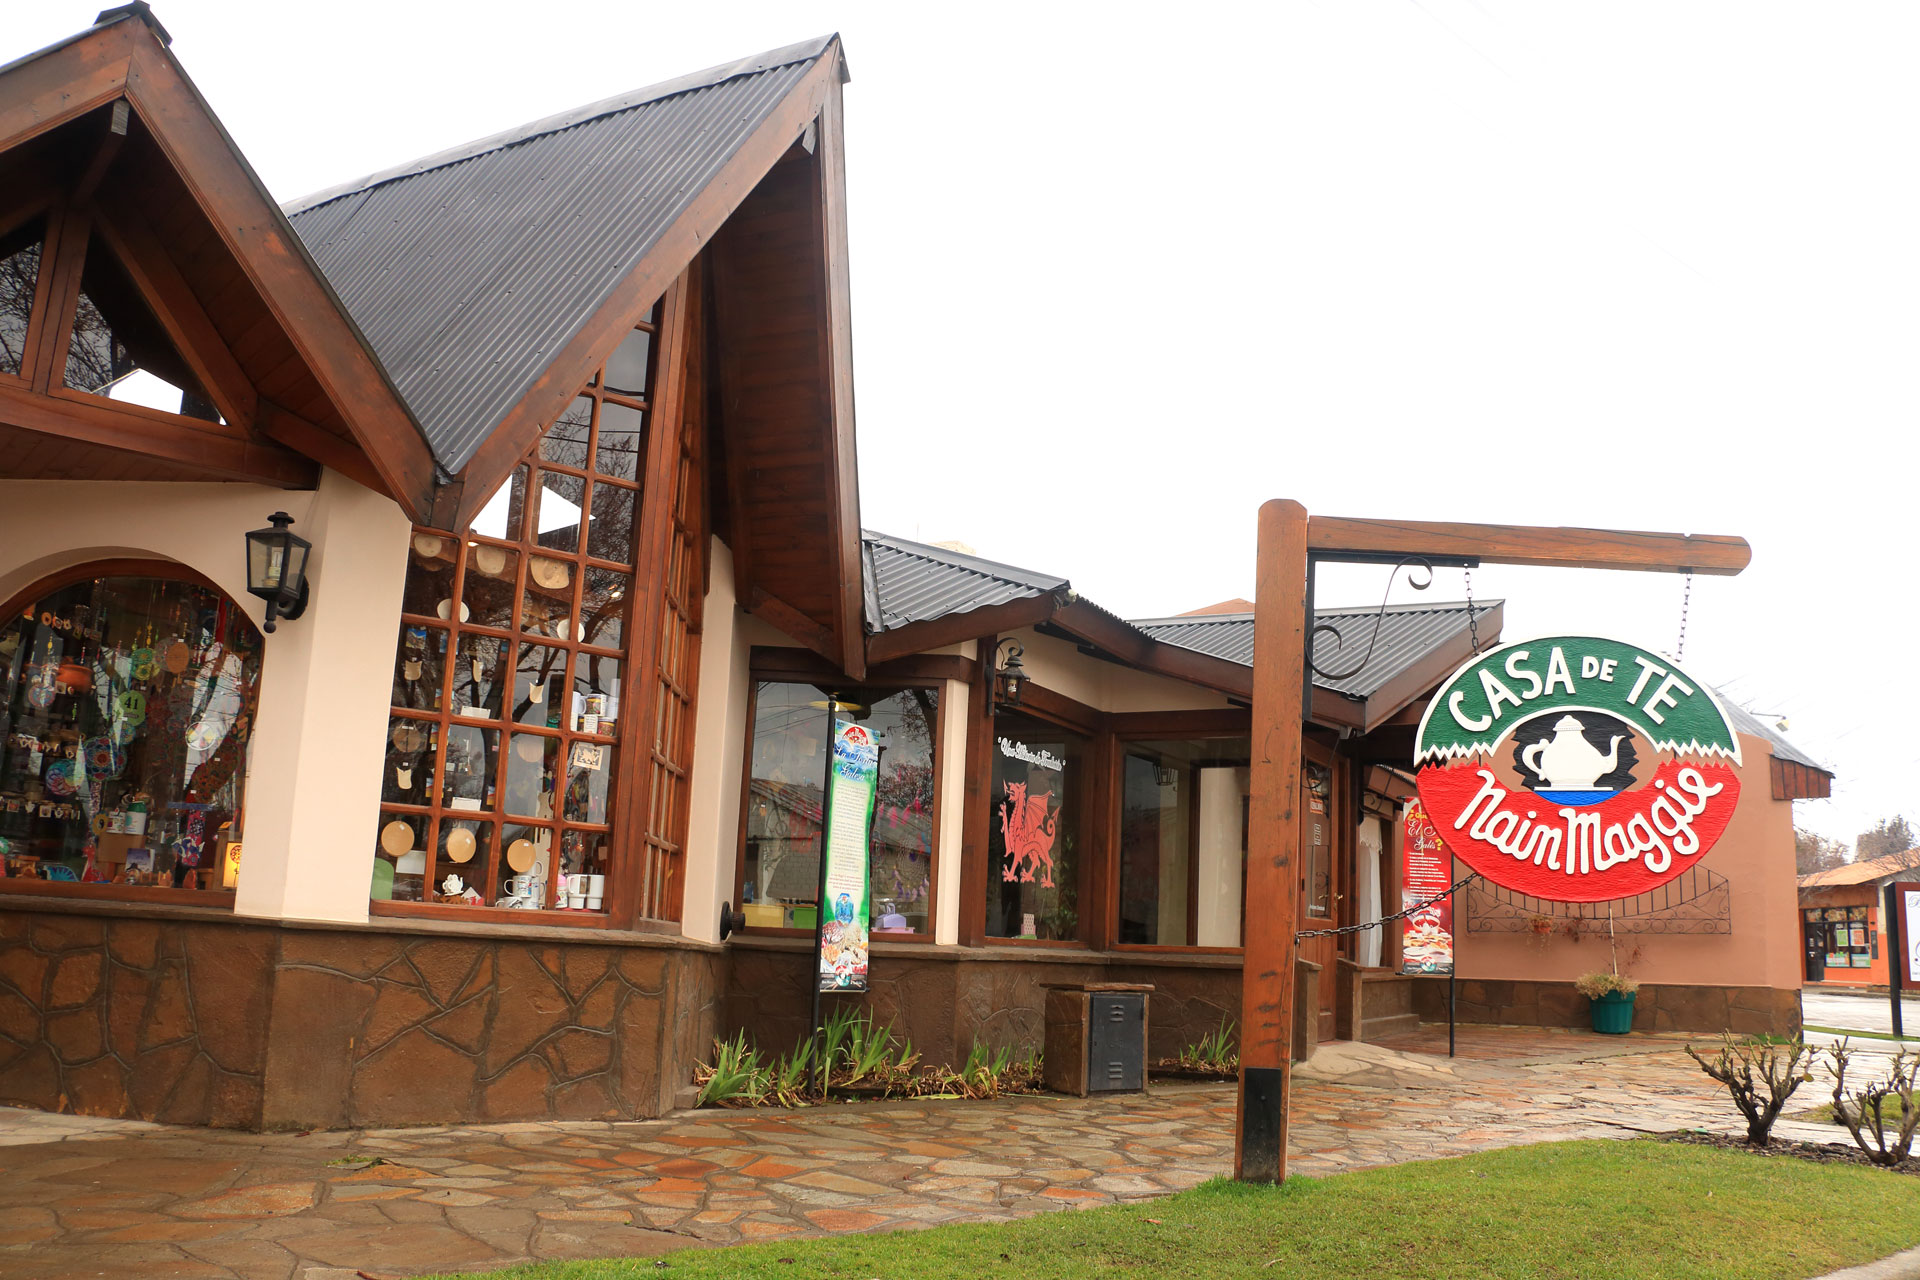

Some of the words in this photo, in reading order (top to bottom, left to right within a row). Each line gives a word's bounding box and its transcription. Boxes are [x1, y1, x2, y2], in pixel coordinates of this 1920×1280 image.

[124, 696, 138, 710] 41
[1449, 647, 1577, 732] CASA
[1580, 655, 1618, 683] DE
[1625, 655, 1694, 726] TE
[1558, 767, 1724, 875] Maggie
